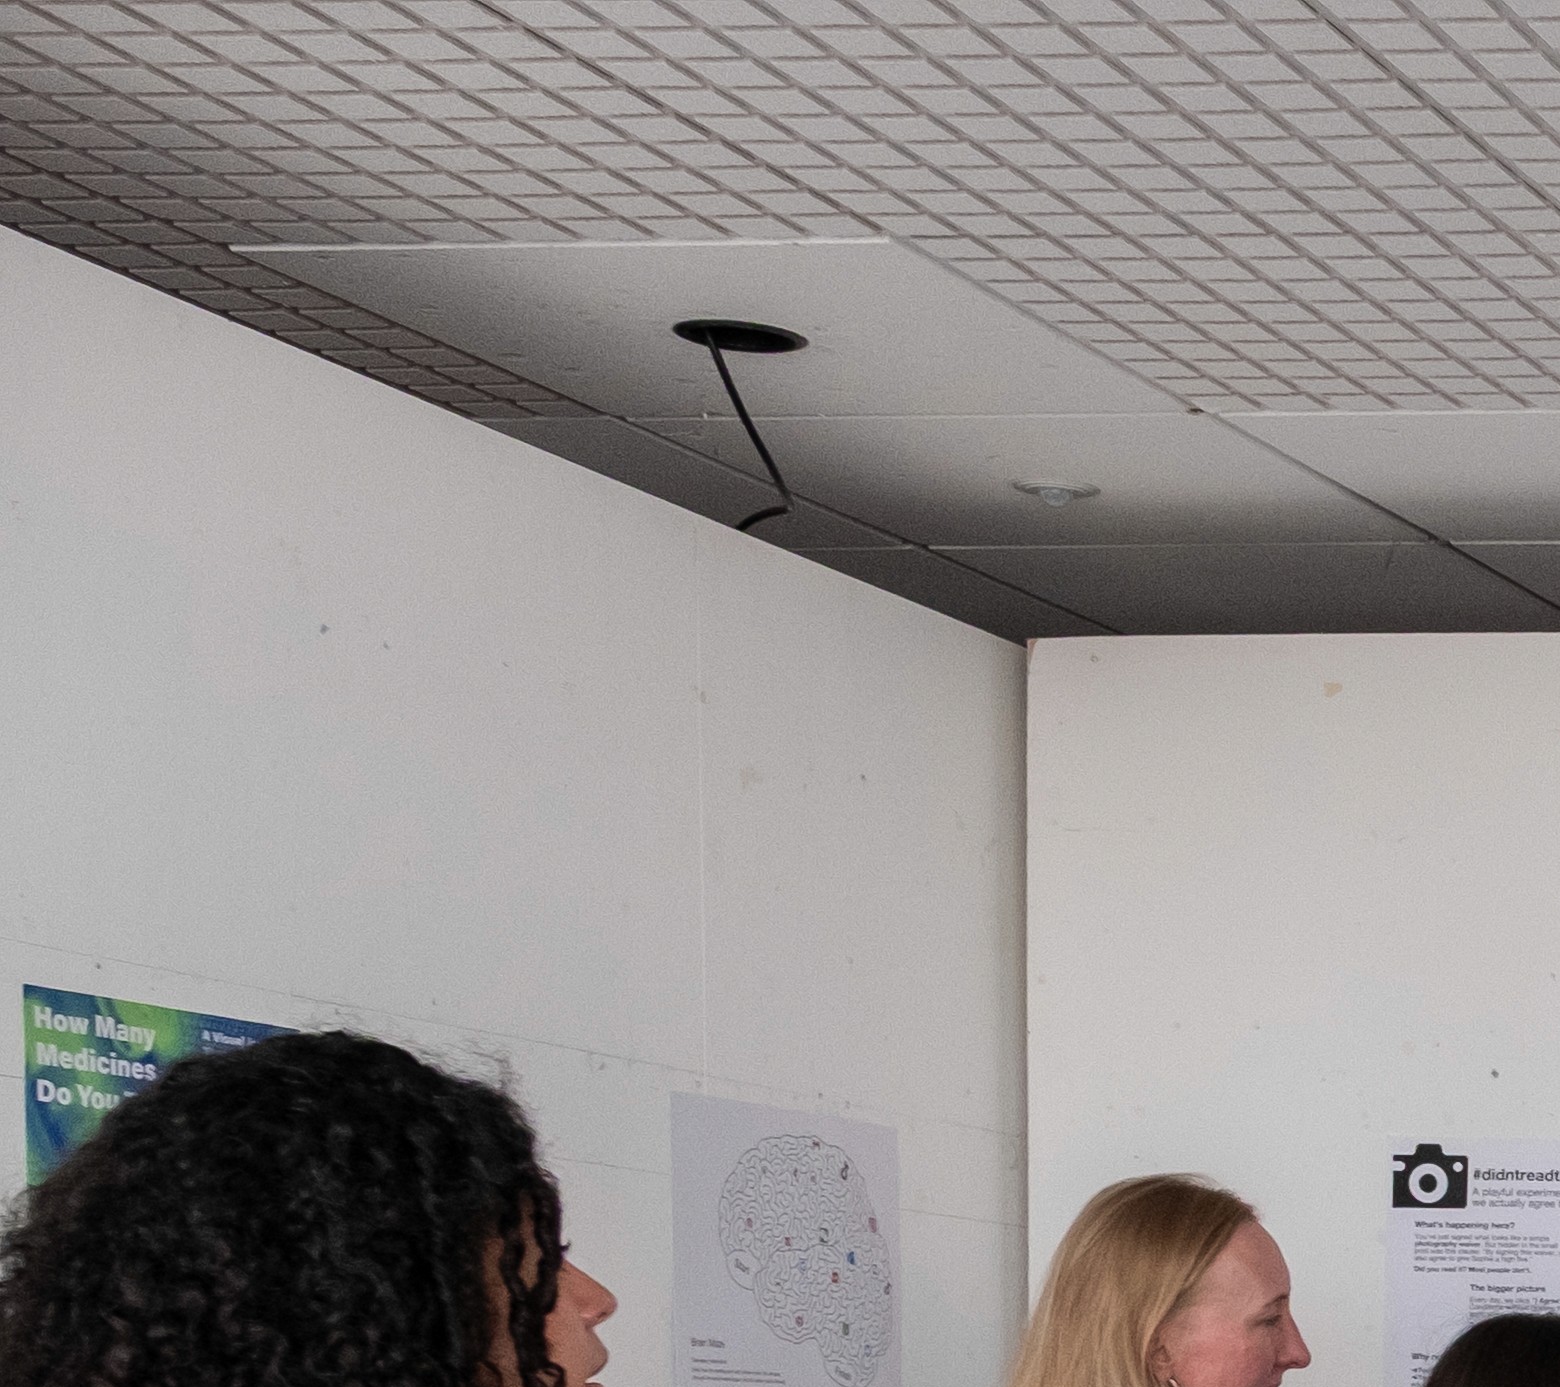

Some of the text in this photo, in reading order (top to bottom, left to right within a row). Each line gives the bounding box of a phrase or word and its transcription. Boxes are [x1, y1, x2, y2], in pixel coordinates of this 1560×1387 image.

[33, 1005, 157, 1051] How Many
[36, 1042, 158, 1082] Medicines
[36, 1079, 120, 1111] Do You
[1472, 1188, 1480, 1196] A
[1482, 1188, 1513, 1198] playful
[1488, 1199, 1526, 1209] actually
[1528, 1200, 1556, 1210] agree
[1415, 1221, 1443, 1229] What's
[1446, 1221, 1489, 1231] happening
[1470, 1284, 1546, 1294] The bigger picture
